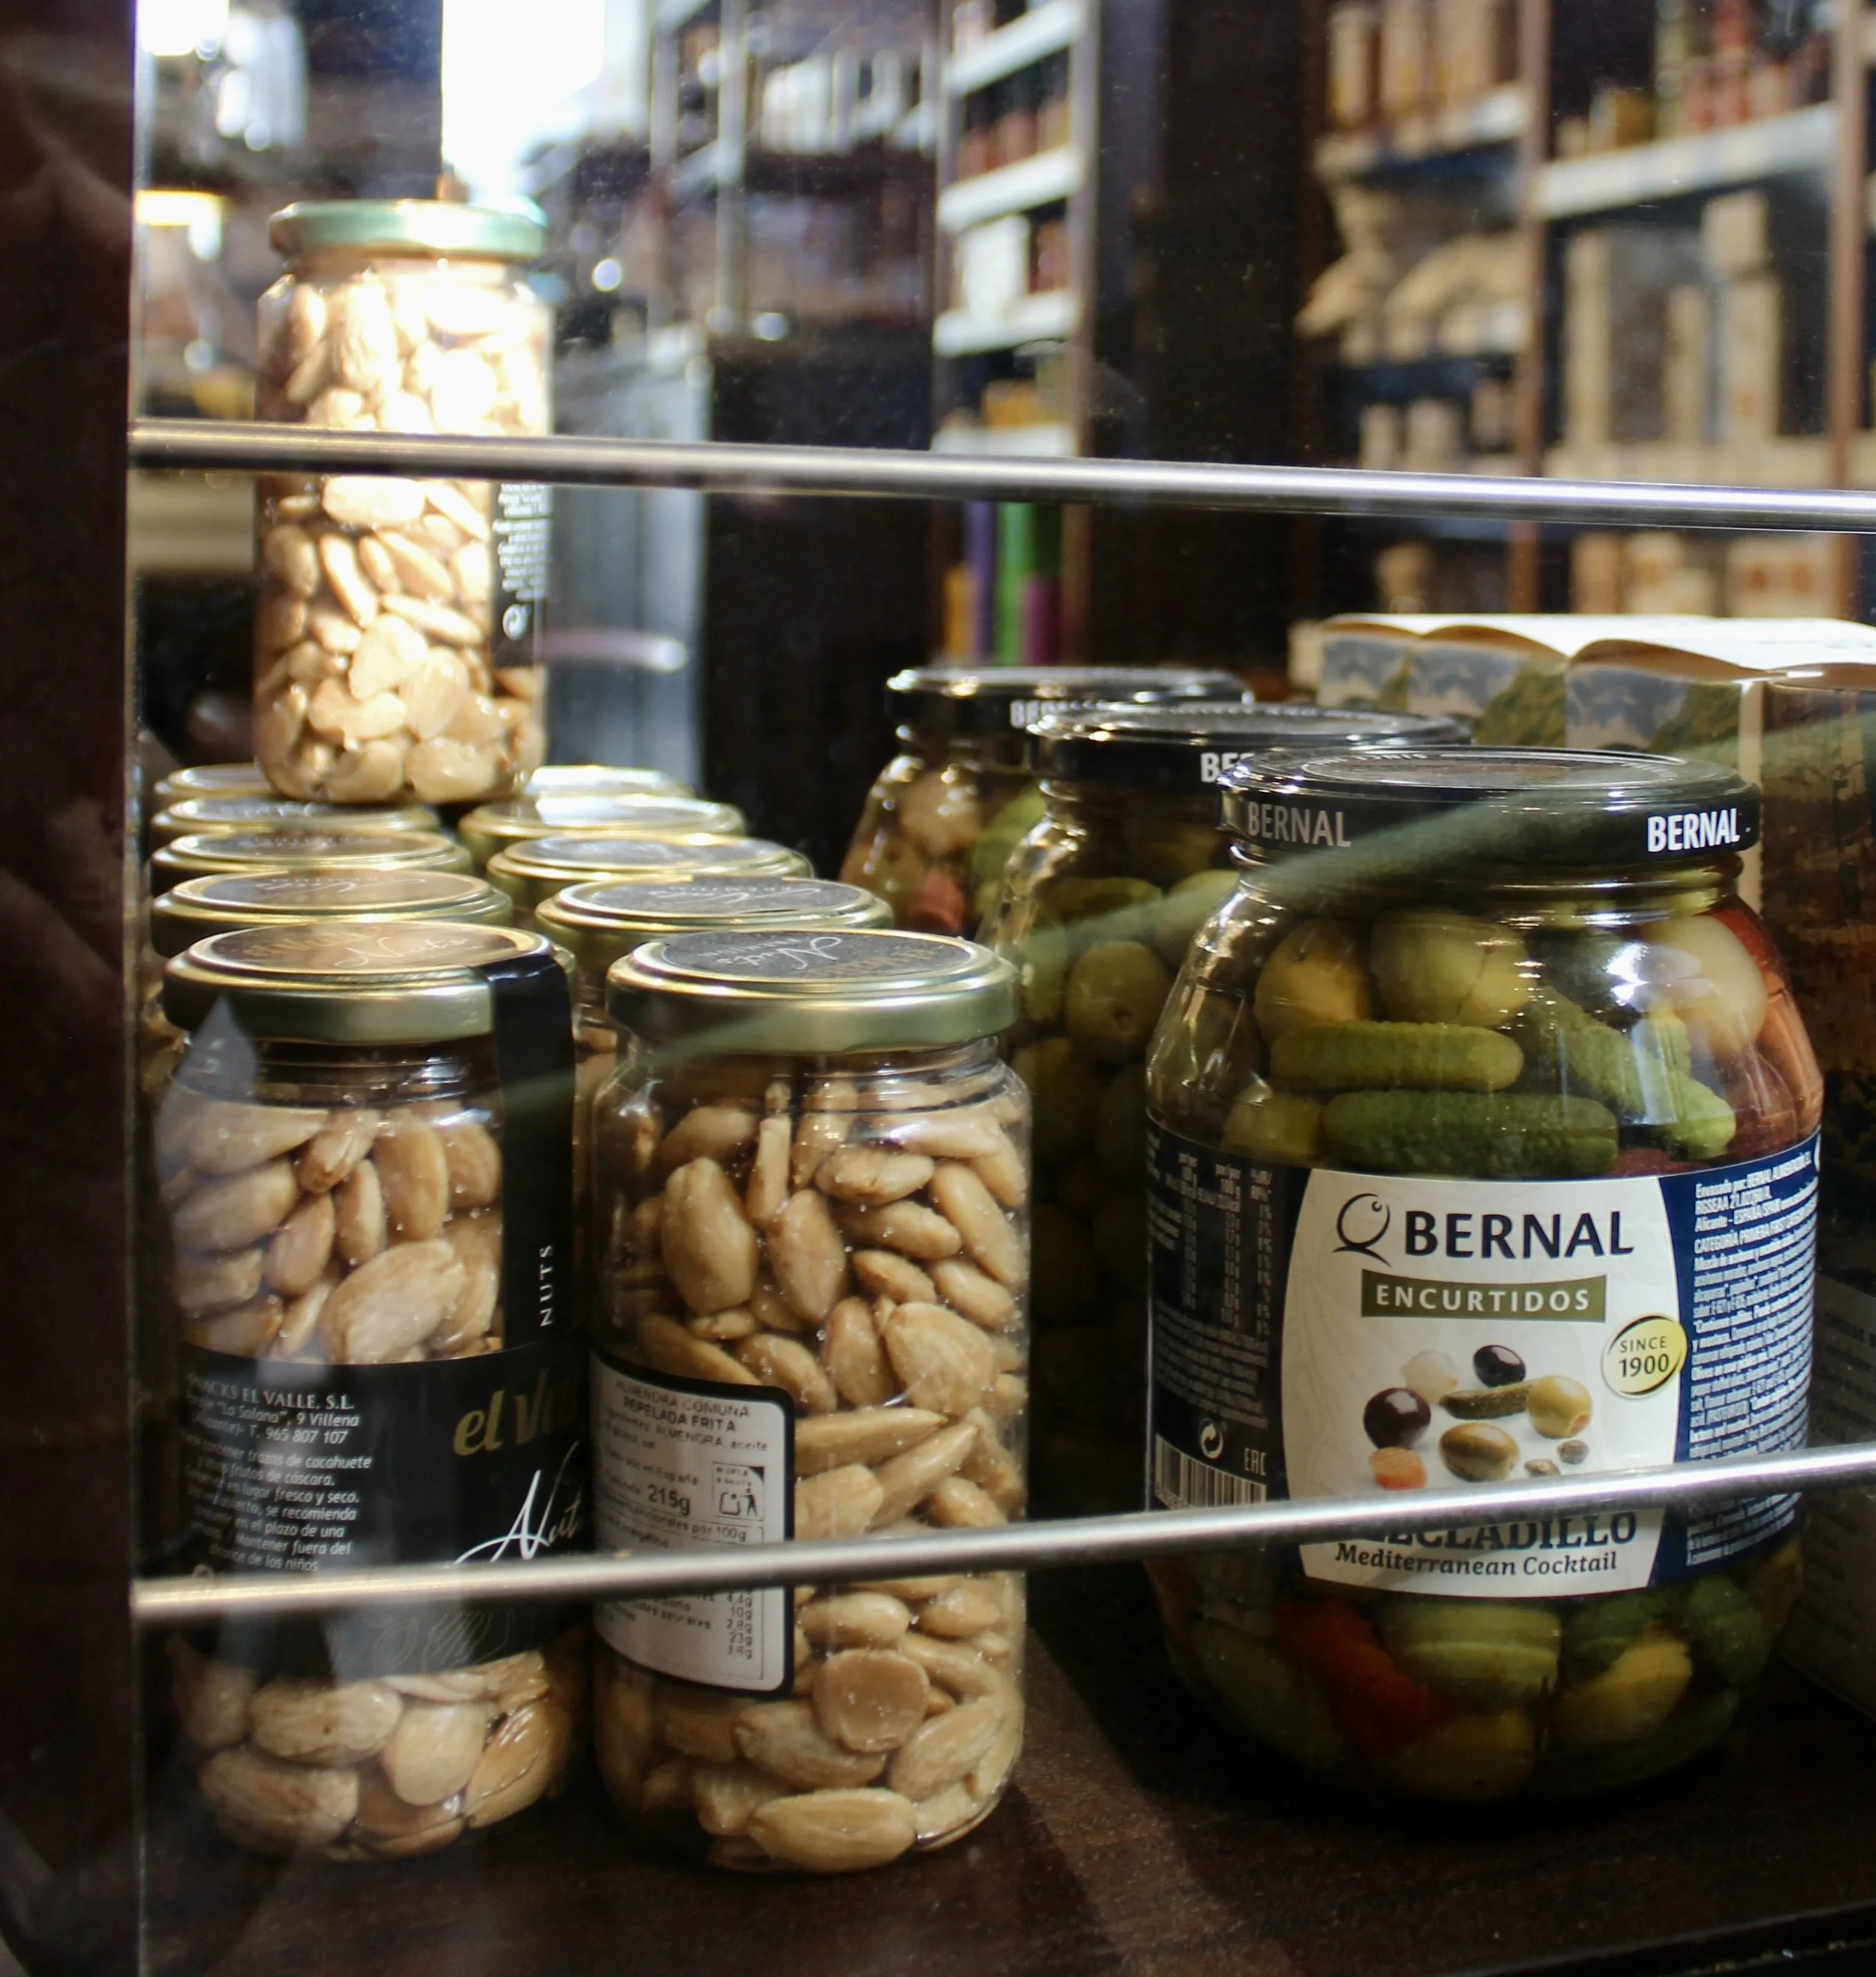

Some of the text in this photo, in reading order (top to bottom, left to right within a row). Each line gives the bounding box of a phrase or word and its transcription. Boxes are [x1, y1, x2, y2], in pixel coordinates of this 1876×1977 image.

[1248, 801, 1351, 847] BERNAL
[1648, 808, 1739, 852] BERNAL
[1405, 1210, 1635, 1259] BERNAL
[540, 1245, 552, 1326] NUTS
[1377, 1284, 1589, 1312] ENCURTIDOS
[1619, 1336, 1667, 1351] SINCE
[1619, 1353, 1669, 1377] 1900
[242, 1388, 260, 1404] EL
[326, 1395, 354, 1410] S.L.
[683, 1398, 750, 1417] COMUNA
[296, 1413, 306, 1426] 9
[309, 1413, 360, 1427] Villena
[452, 1390, 504, 1456] el
[692, 1415, 735, 1432] FRITA
[266, 1428, 290, 1442] 965
[293, 1428, 318, 1443] 807
[323, 1431, 348, 1444] 107
[248, 1451, 283, 1465] trazas
[287, 1452, 302, 1467] de
[306, 1455, 372, 1469] cacahuete
[267, 1470, 281, 1483] de
[273, 1487, 313, 1503] fresco
[316, 1492, 324, 1506] y
[647, 1484, 690, 1516] 215g
[266, 1505, 278, 1517] se
[282, 1507, 356, 1521] recomienda
[265, 1521, 297, 1536] plazo
[301, 1524, 316, 1537] de
[321, 1526, 345, 1538] una
[717, 1527, 747, 1542] 100g
[291, 1539, 326, 1556] fuera
[329, 1540, 351, 1555] del
[248, 1551, 261, 1566] de
[266, 1554, 281, 1569] los
[285, 1557, 318, 1572] niños
[1335, 1542, 1617, 1575] Mediterranean Cocktail
